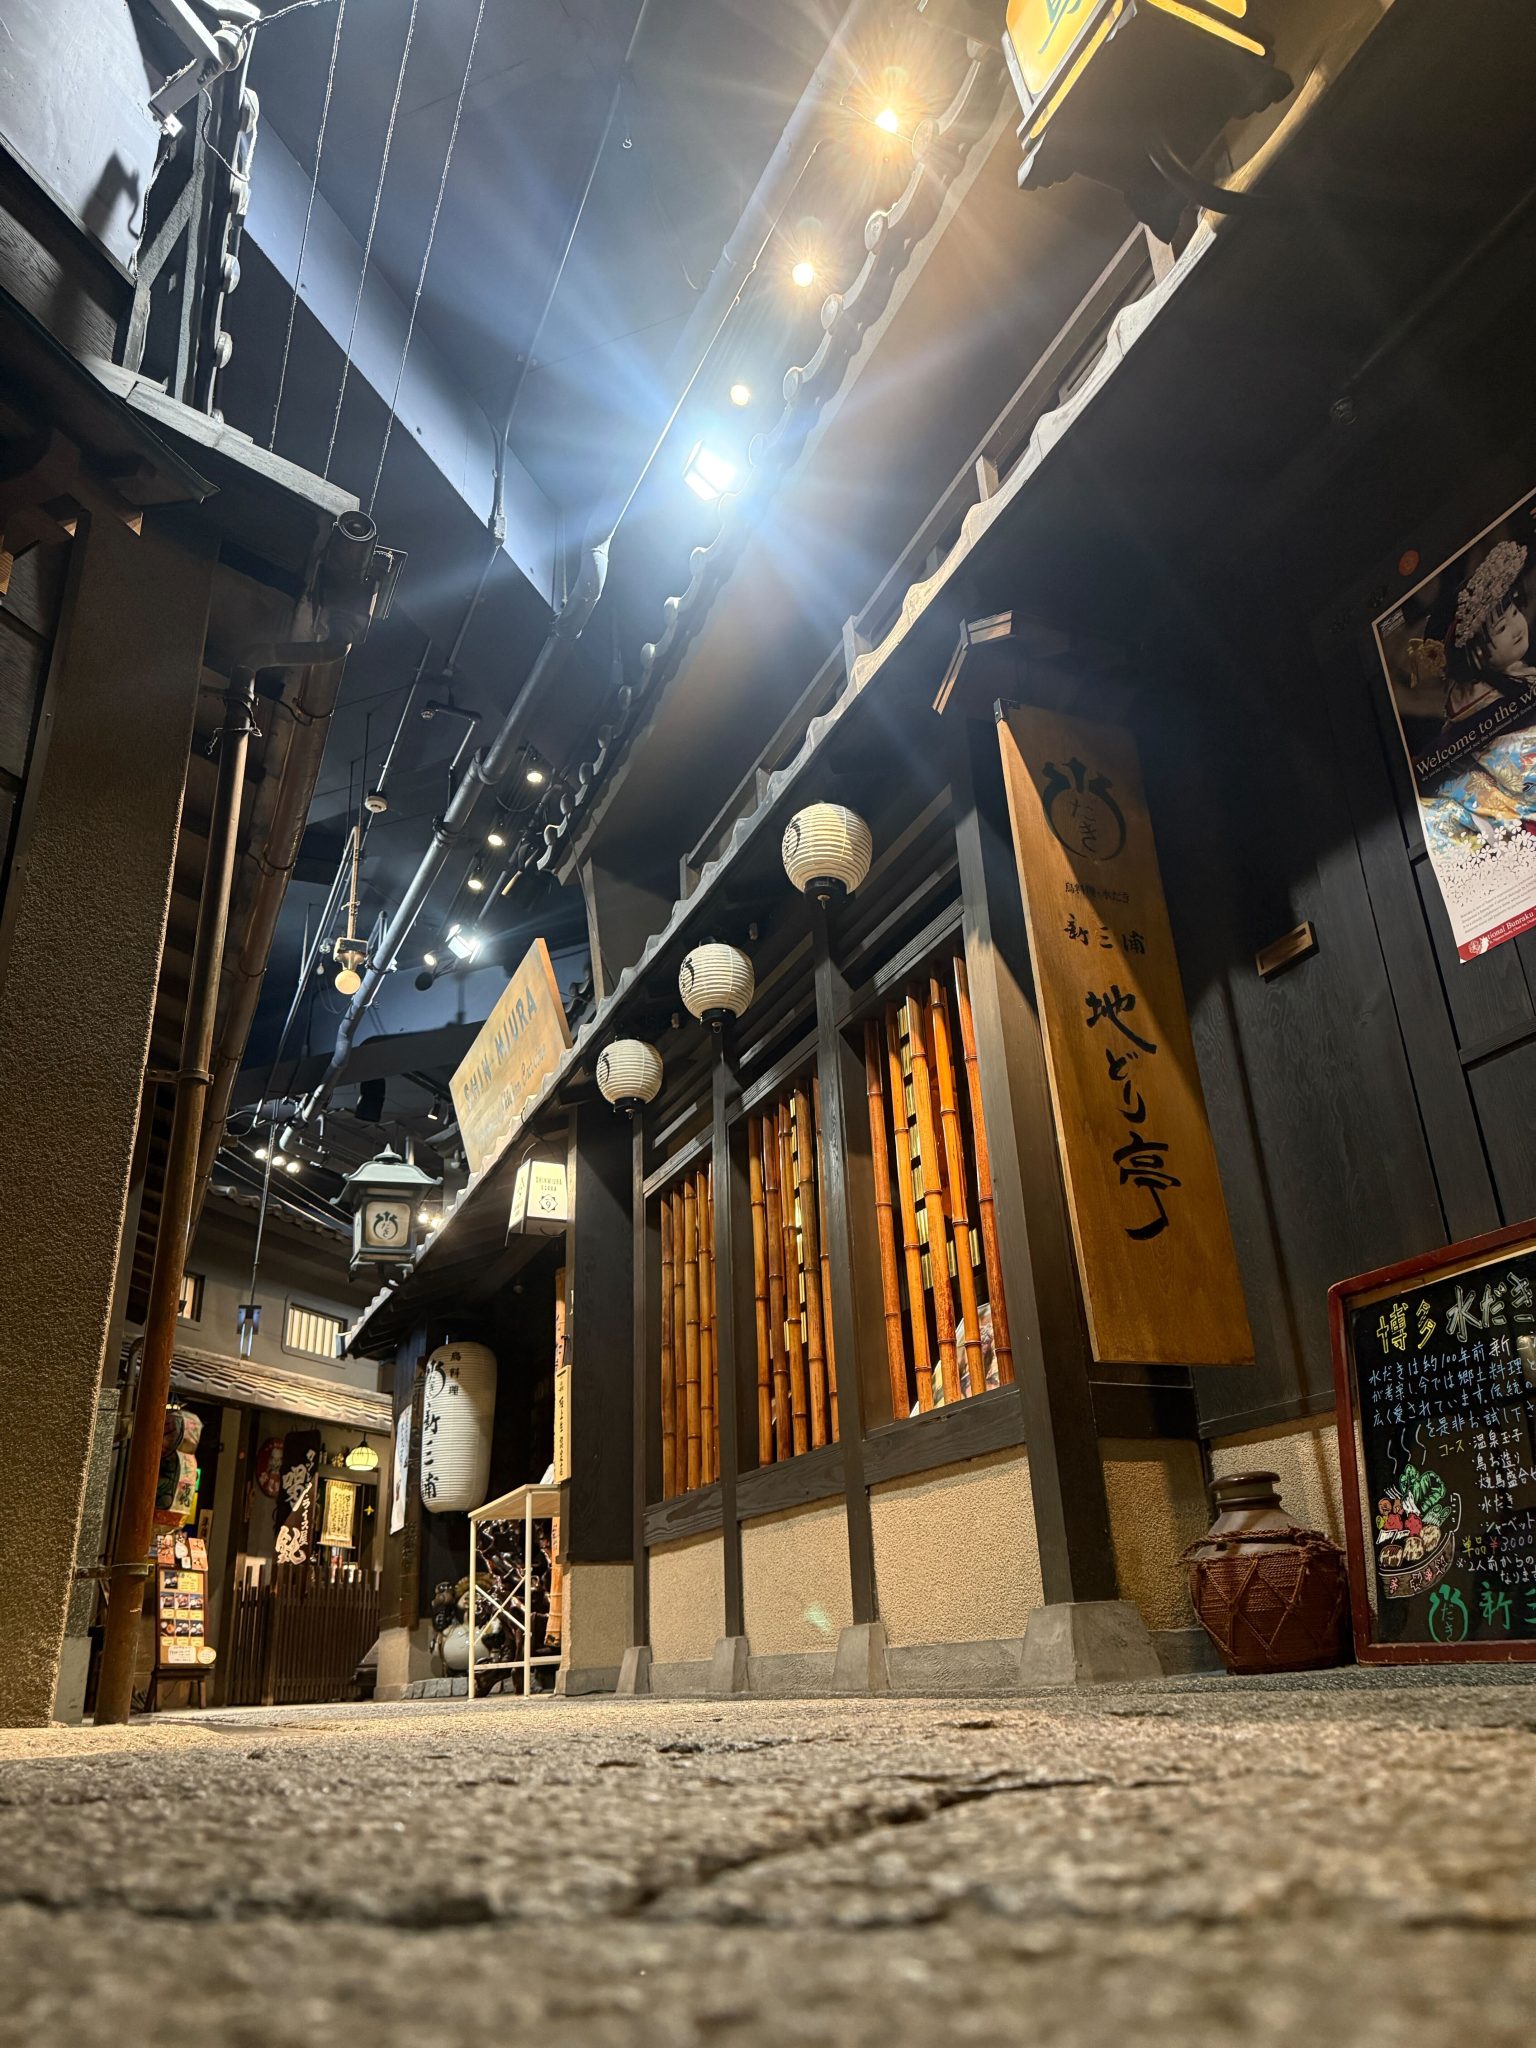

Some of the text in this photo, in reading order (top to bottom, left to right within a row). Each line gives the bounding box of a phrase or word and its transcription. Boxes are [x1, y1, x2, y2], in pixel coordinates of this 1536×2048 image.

[1416, 730, 1477, 775] Welcome
[1478, 719, 1493, 734] to
[1495, 701, 1518, 723] the
[1063, 912, 1146, 955] 新三浦
[1506, 911, 1534, 930] Bunraku
[1084, 983, 1183, 1243] 地どり亭
[1376, 1271, 1536, 1354] 博多 水だき
[1438, 1439, 1465, 1457] コース
[1461, 1535, 1486, 1558] 単品
